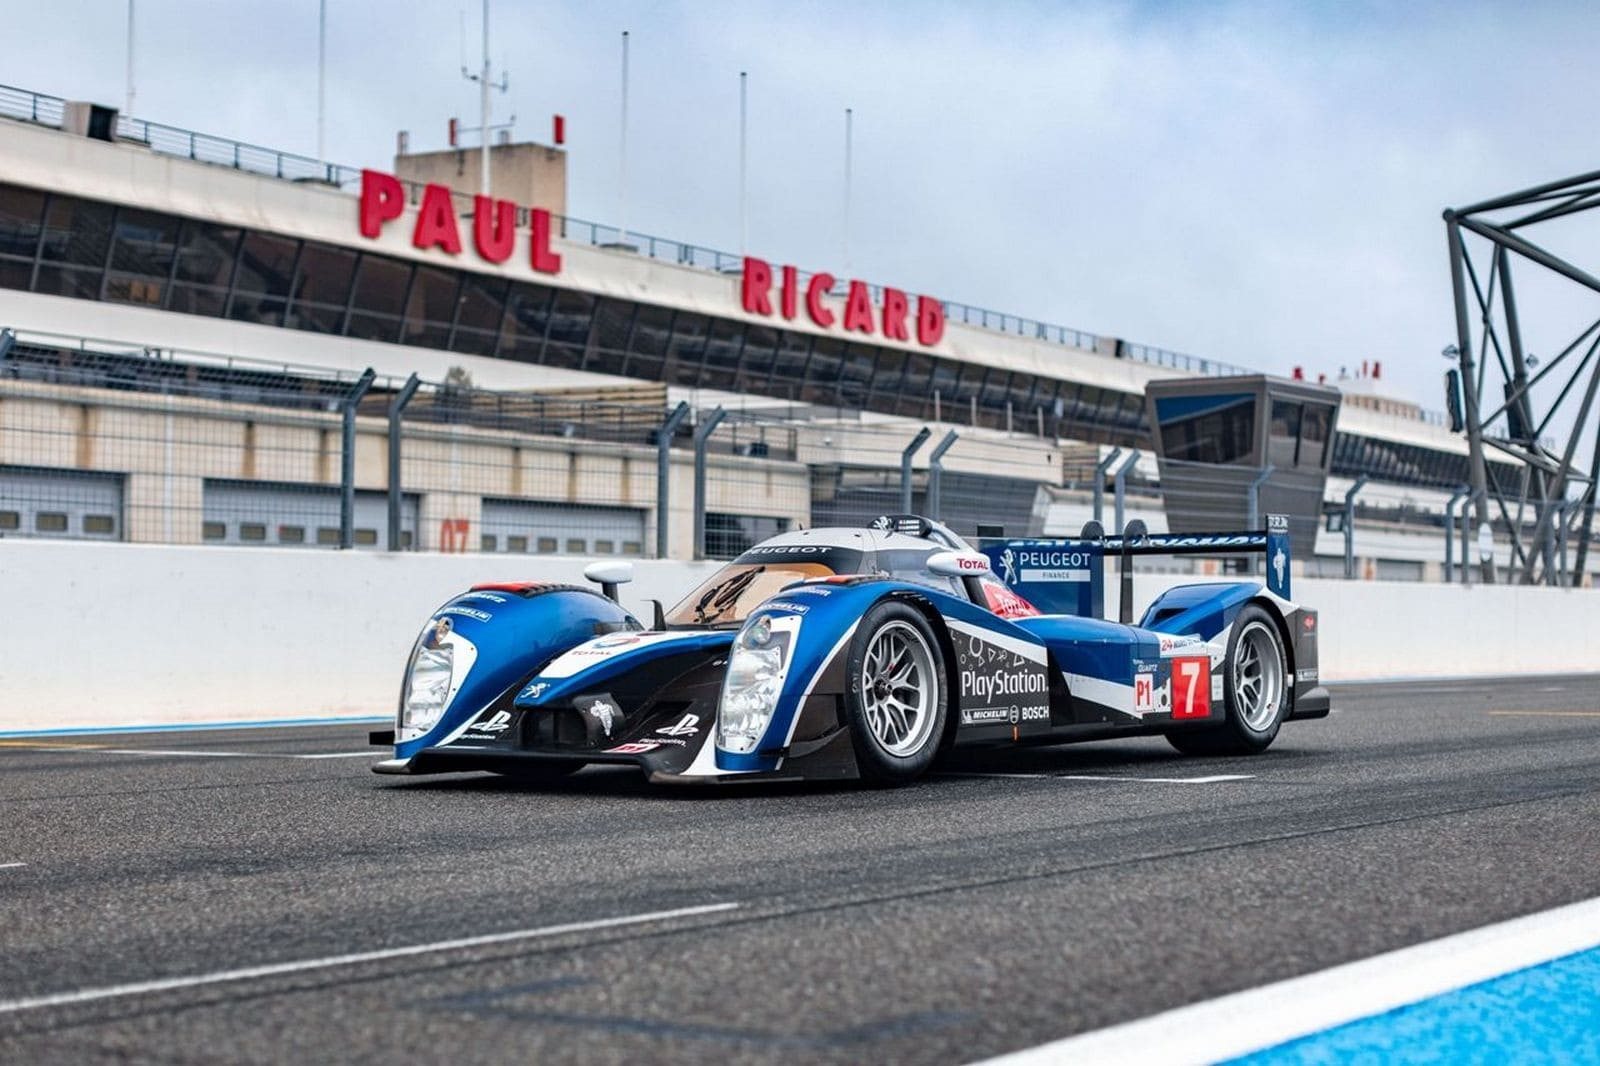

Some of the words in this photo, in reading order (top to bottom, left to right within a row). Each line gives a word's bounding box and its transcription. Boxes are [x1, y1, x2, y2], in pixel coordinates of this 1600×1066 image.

[359, 168, 562, 274] PAUL
[742, 256, 946, 347] RICARD
[1019, 552, 1091, 566] PEUGEOT
[1042, 572, 1070, 580] FINANCE
[961, 669, 1046, 704] PlayStation
[1136, 680, 1151, 706] P1
[1181, 662, 1201, 714] 7
[972, 710, 1008, 719] MICHELIN
[1022, 706, 1050, 720] BOSCH
